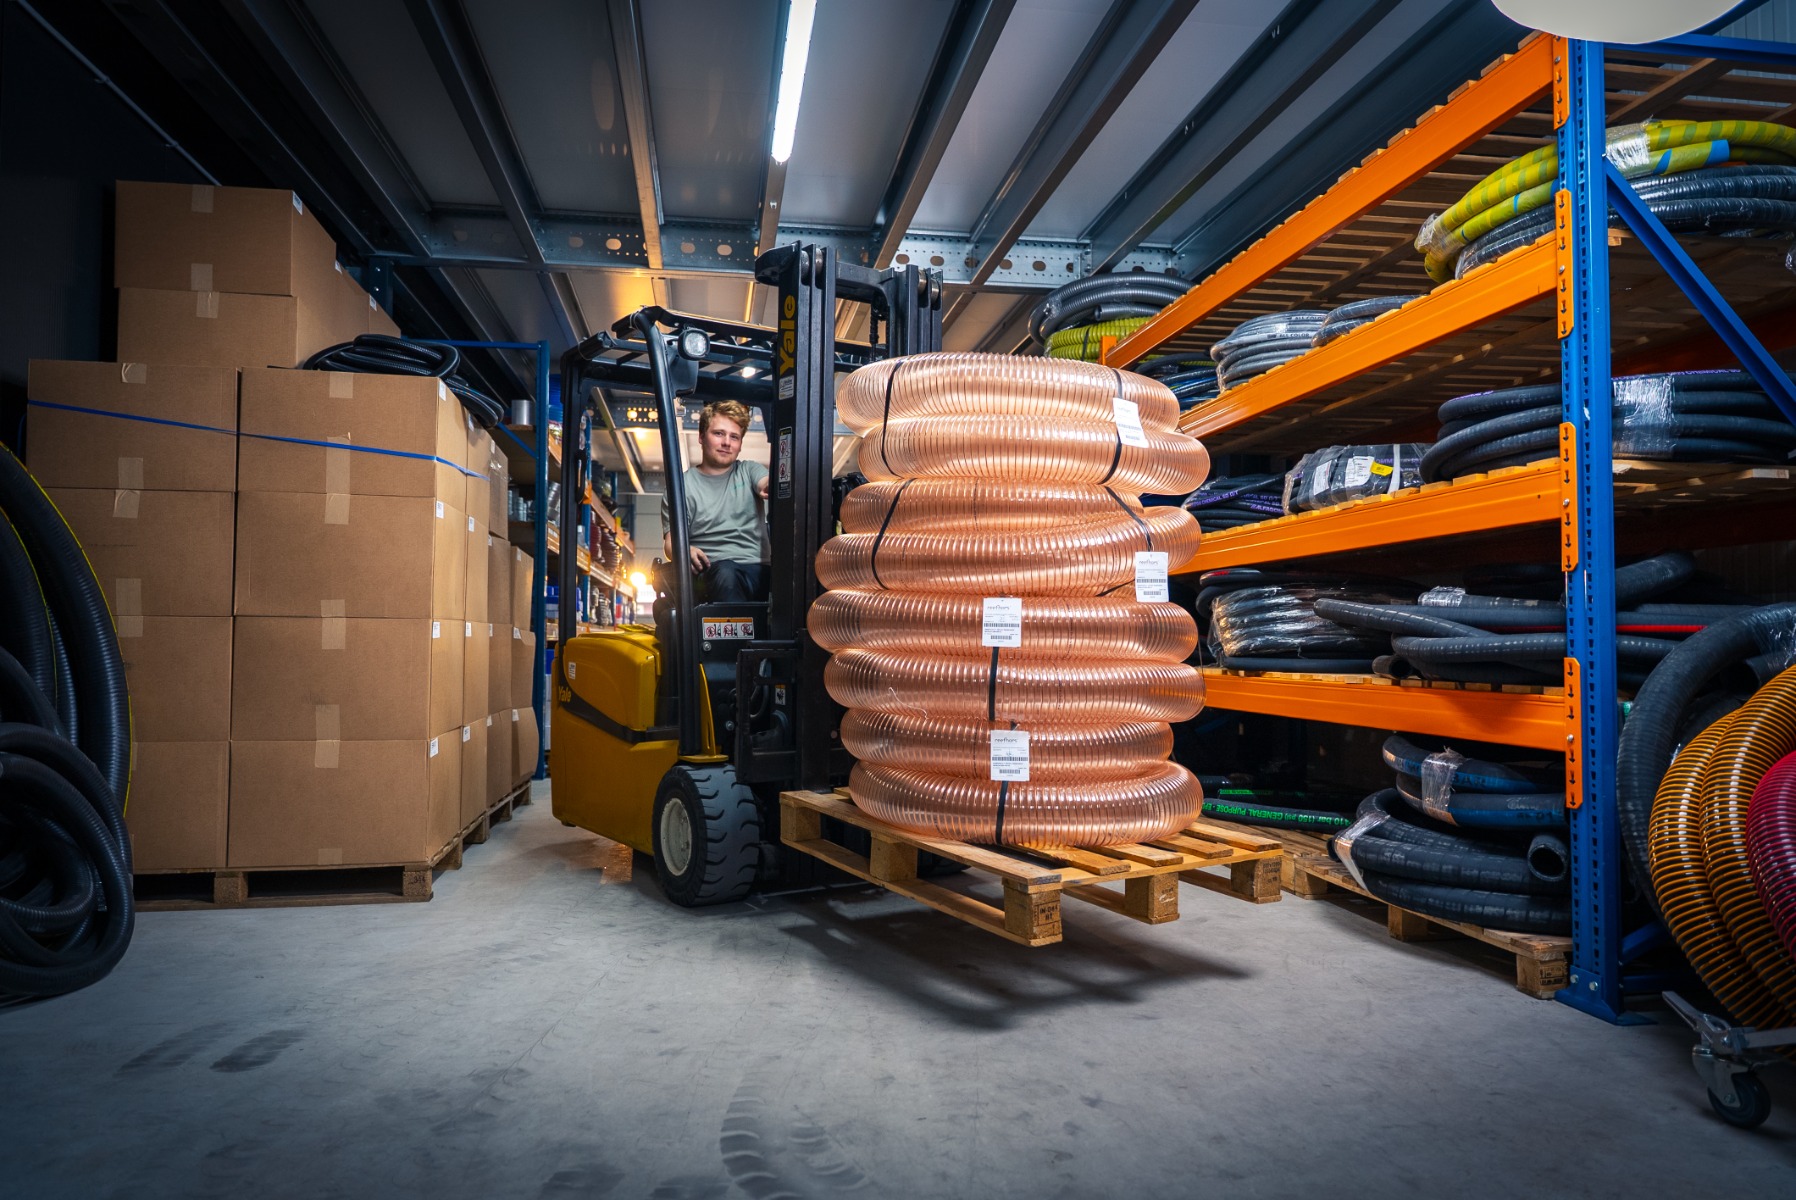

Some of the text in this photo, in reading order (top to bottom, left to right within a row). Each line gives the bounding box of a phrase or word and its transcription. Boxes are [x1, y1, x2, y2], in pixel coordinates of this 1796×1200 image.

[779, 294, 796, 376] Yale
[1216, 804, 1247, 816] PURPOSE
[1249, 808, 1283, 821] GENERAL
[1317, 816, 1332, 825] bar
